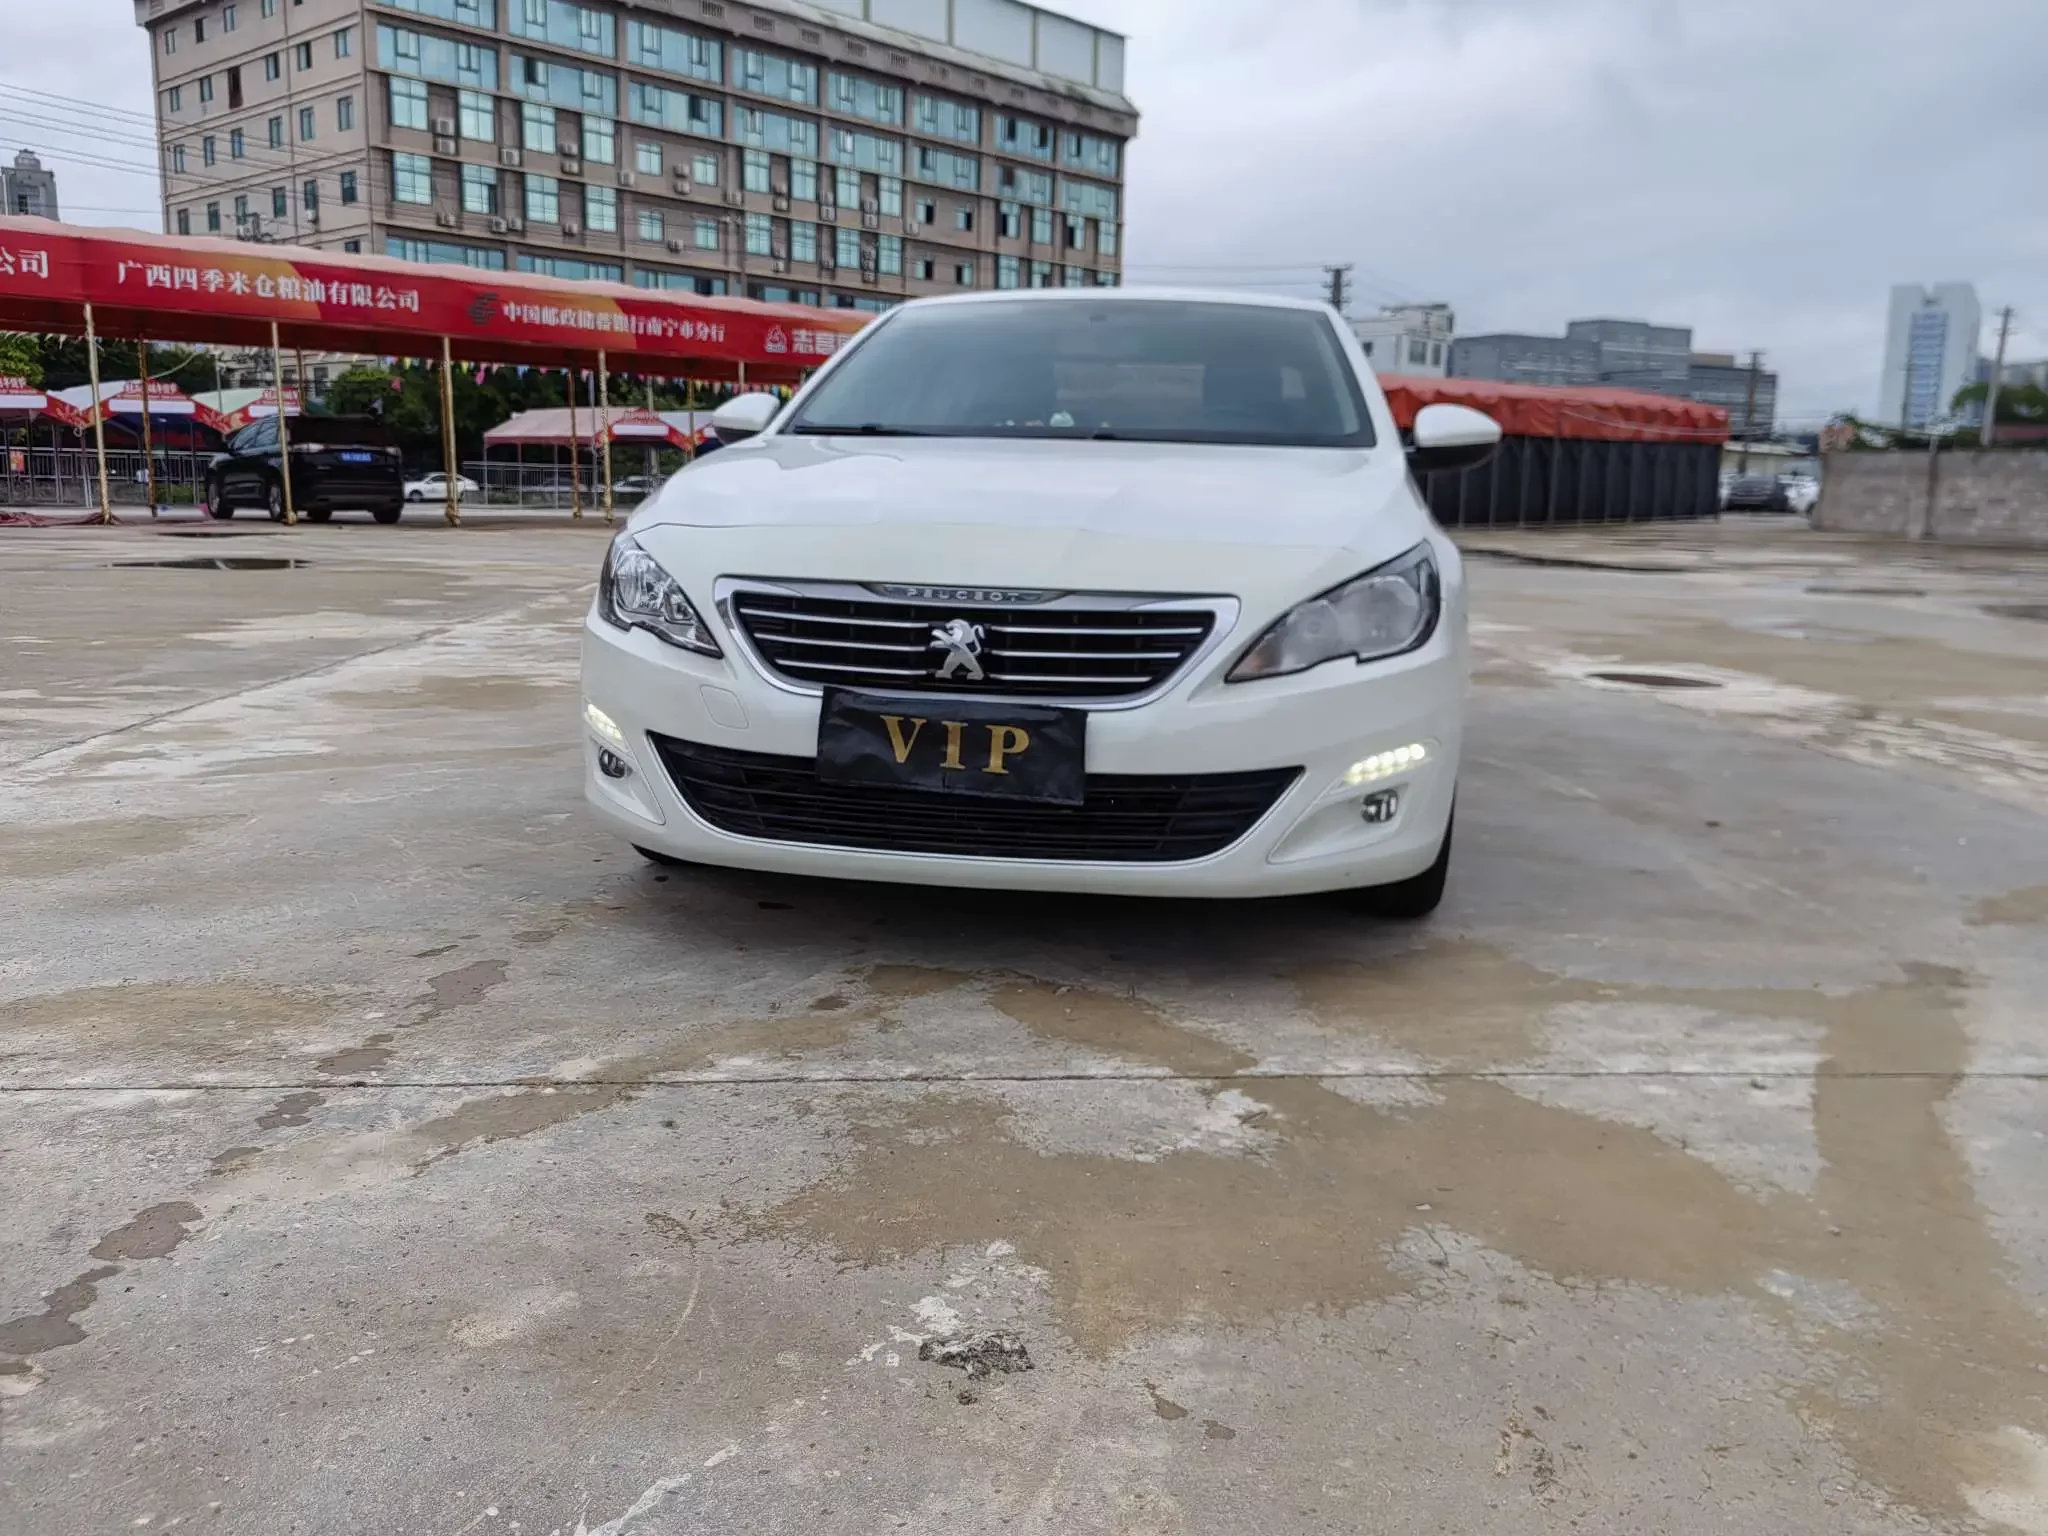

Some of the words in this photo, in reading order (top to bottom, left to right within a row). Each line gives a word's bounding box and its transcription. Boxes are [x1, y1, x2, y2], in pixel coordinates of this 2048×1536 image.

[117, 260, 420, 313] 广西四季米仓粮油有限公司
[907, 588, 1019, 602] PEUGEOT
[881, 715, 1030, 774] VIP
